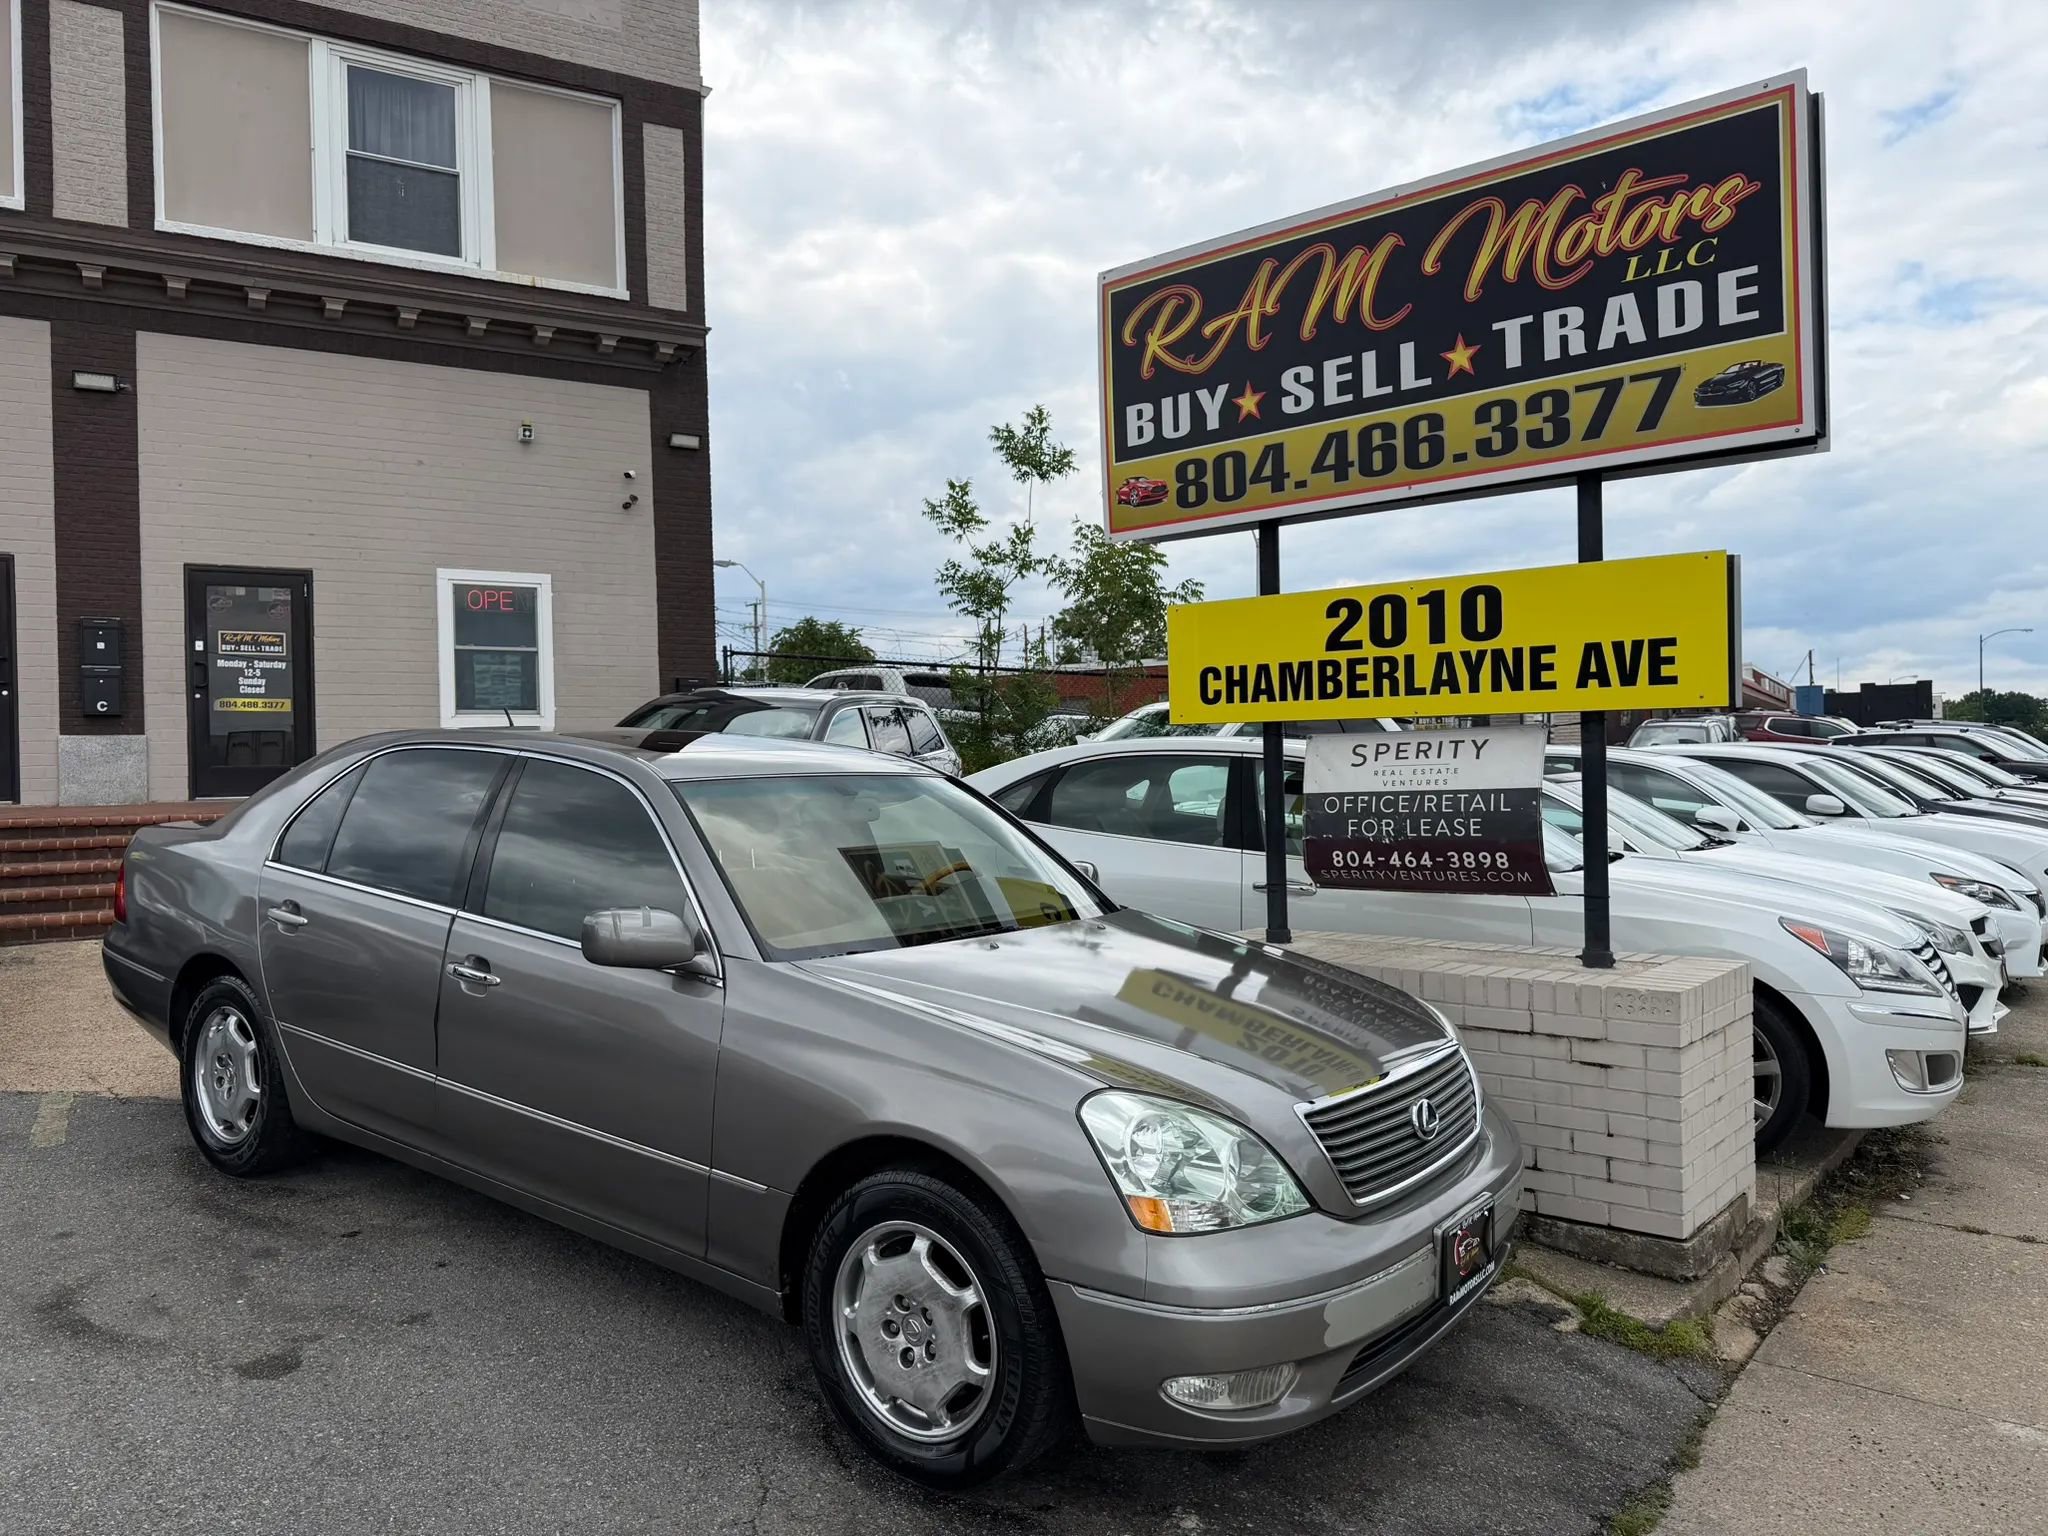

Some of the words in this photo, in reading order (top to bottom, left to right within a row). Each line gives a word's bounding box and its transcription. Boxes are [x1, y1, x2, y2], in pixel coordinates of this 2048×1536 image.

[1621, 237, 1719, 283] LLC
[1122, 232, 1412, 380] RAM
[1421, 167, 1762, 302] Motors
[1126, 383, 1230, 447] BUY
[1280, 341, 1432, 414] SELL
[1491, 265, 1760, 369] TRADE
[1174, 365, 1682, 509] 804.466.3377
[1324, 585, 1503, 652] 2010
[217, 659, 247, 668] Monday
[253, 660, 286, 669] Saturday
[244, 669, 261, 677] 12-5
[1199, 644, 1556, 706] CHAMBERLAYNE
[1575, 637, 1679, 690] AVE
[238, 677, 266, 685] Sunday
[240, 686, 266, 694] Closed
[96, 701, 108, 712] C
[1350, 738, 1490, 768] SPERITY
[1373, 768, 1403, 777] REAL
[1412, 767, 1459, 776] ESTATE
[1382, 778, 1448, 787] VENTURES
[1323, 792, 1511, 814] OFFICE/RETAIL
[1348, 818, 1395, 837] FOR
[1406, 818, 1483, 837] LEASE
[1332, 850, 1510, 869] 804-464-3898
[1320, 869, 1533, 883] SPERITYVENTURES.COM
